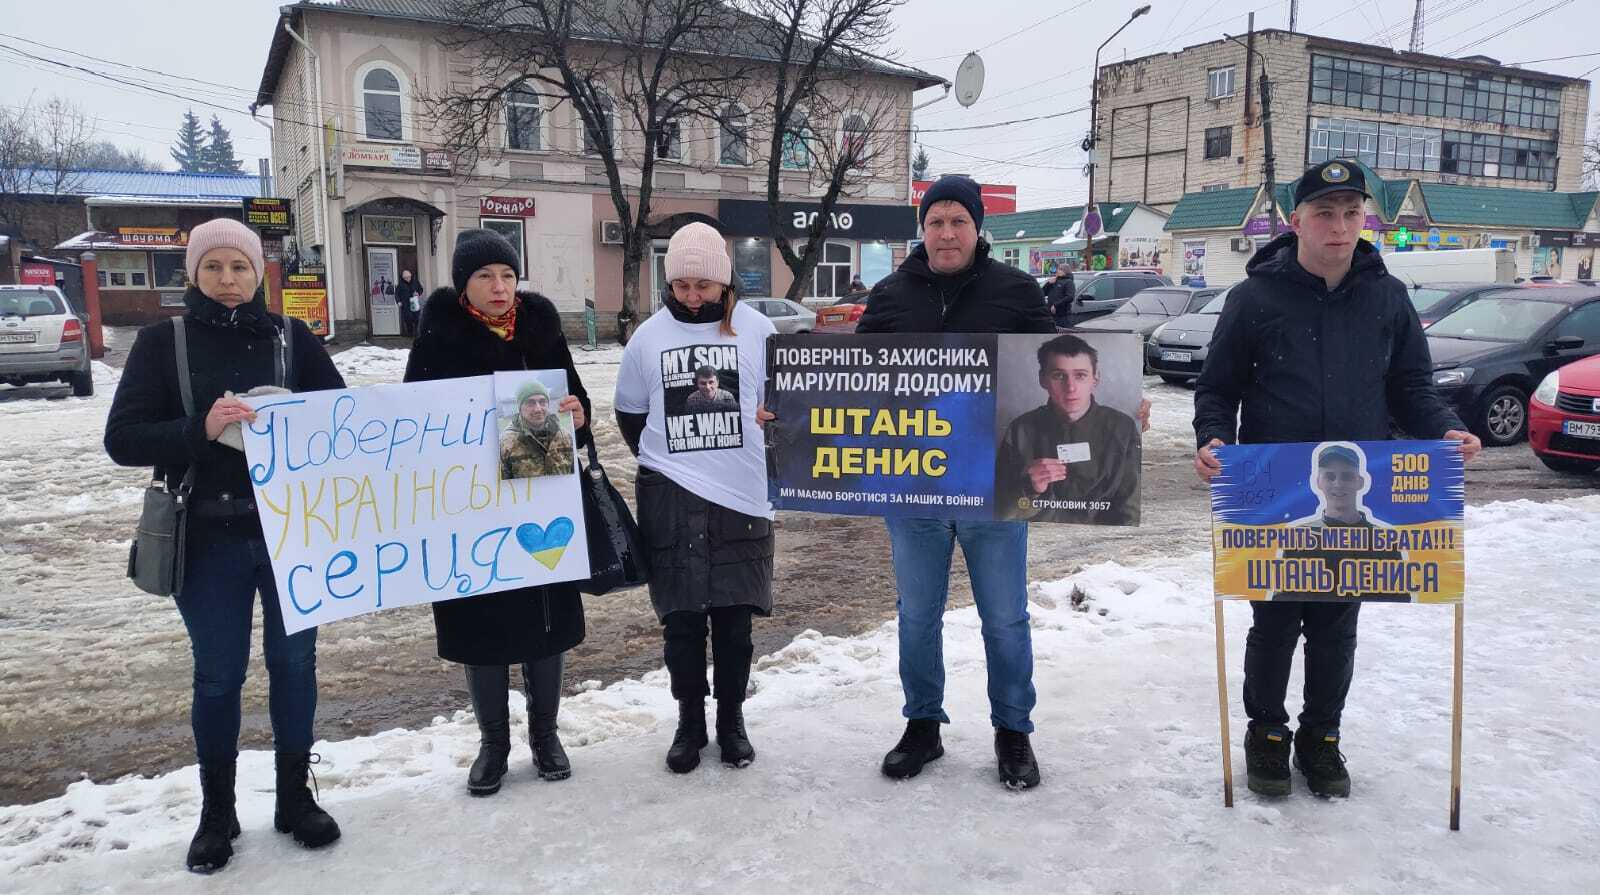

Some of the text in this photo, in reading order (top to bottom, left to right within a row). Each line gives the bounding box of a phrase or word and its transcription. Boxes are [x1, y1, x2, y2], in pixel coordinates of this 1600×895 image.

[348, 151, 389, 161] ЛОМБАРД
[480, 197, 533, 214] ТОРНАДО
[122, 233, 171, 243] ШАУРМА
[662, 346, 738, 376] MY SON
[775, 348, 989, 368] ПОВЕРНІТЬ ЗАХИСНИКА
[775, 372, 991, 396] МАРІУПОЛЯ ДОДОМУ!
[667, 411, 740, 439] WE WAIT
[809, 407, 953, 437] ШТАНЬ
[1569, 422, 1583, 433] BM
[669, 433, 742, 452] FOR HIM AT HOME
[812, 446, 948, 479] ДЕНИС
[1391, 453, 1429, 473] 500
[1391, 475, 1429, 492] ДНІВ
[780, 487, 984, 506] МИ МАЄМО БОРОТИСЯ ЗА НАШИХ ВОЇНІВ!
[1032, 500, 1111, 511] СТРОКОВИК 3057
[1391, 493, 1429, 503] ПОЛОНУ
[1222, 528, 1455, 551] ПОВЕРНІТЬ МЕНІ БРАТА!!!
[1247, 559, 1439, 597] ШТАНЬ ДЕНИСА
